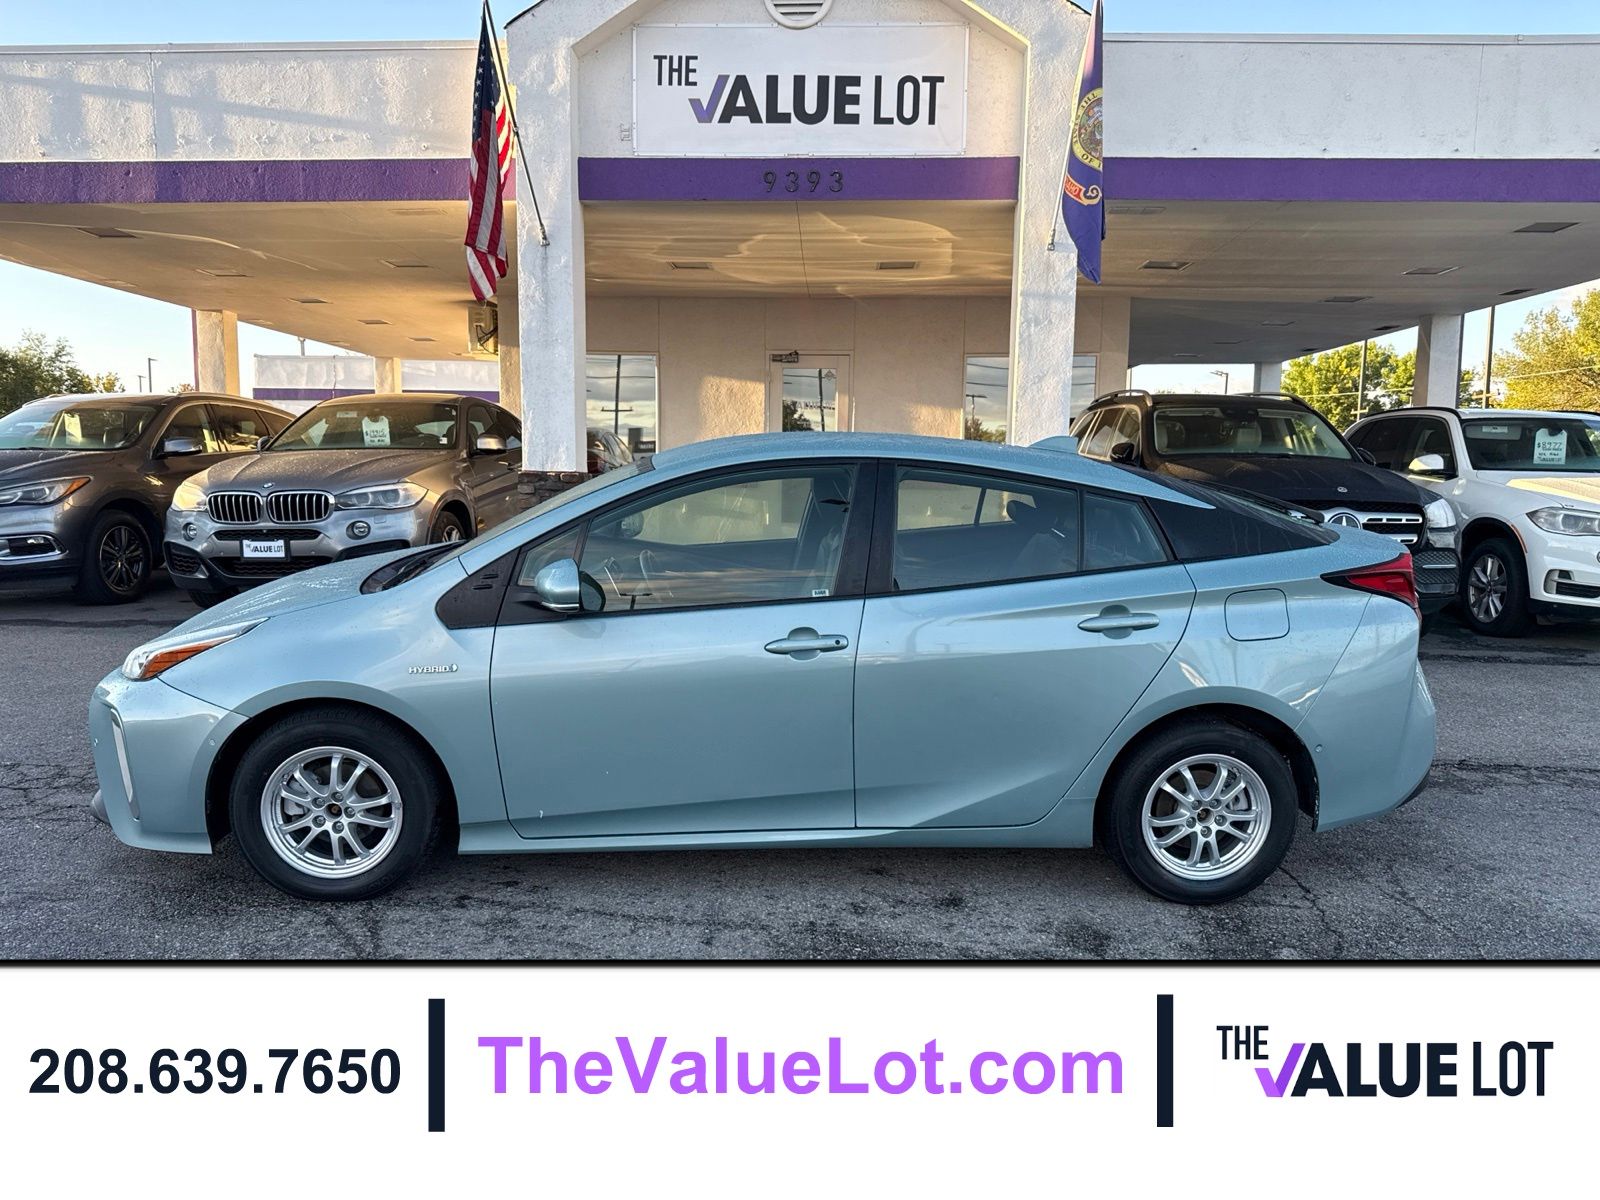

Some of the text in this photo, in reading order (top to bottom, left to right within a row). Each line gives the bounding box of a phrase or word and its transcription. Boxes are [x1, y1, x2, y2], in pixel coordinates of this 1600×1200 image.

[653, 55, 945, 125] THE VALUE LOT
[763, 170, 843, 193] 9393
[408, 665, 450, 674] HYBRID
